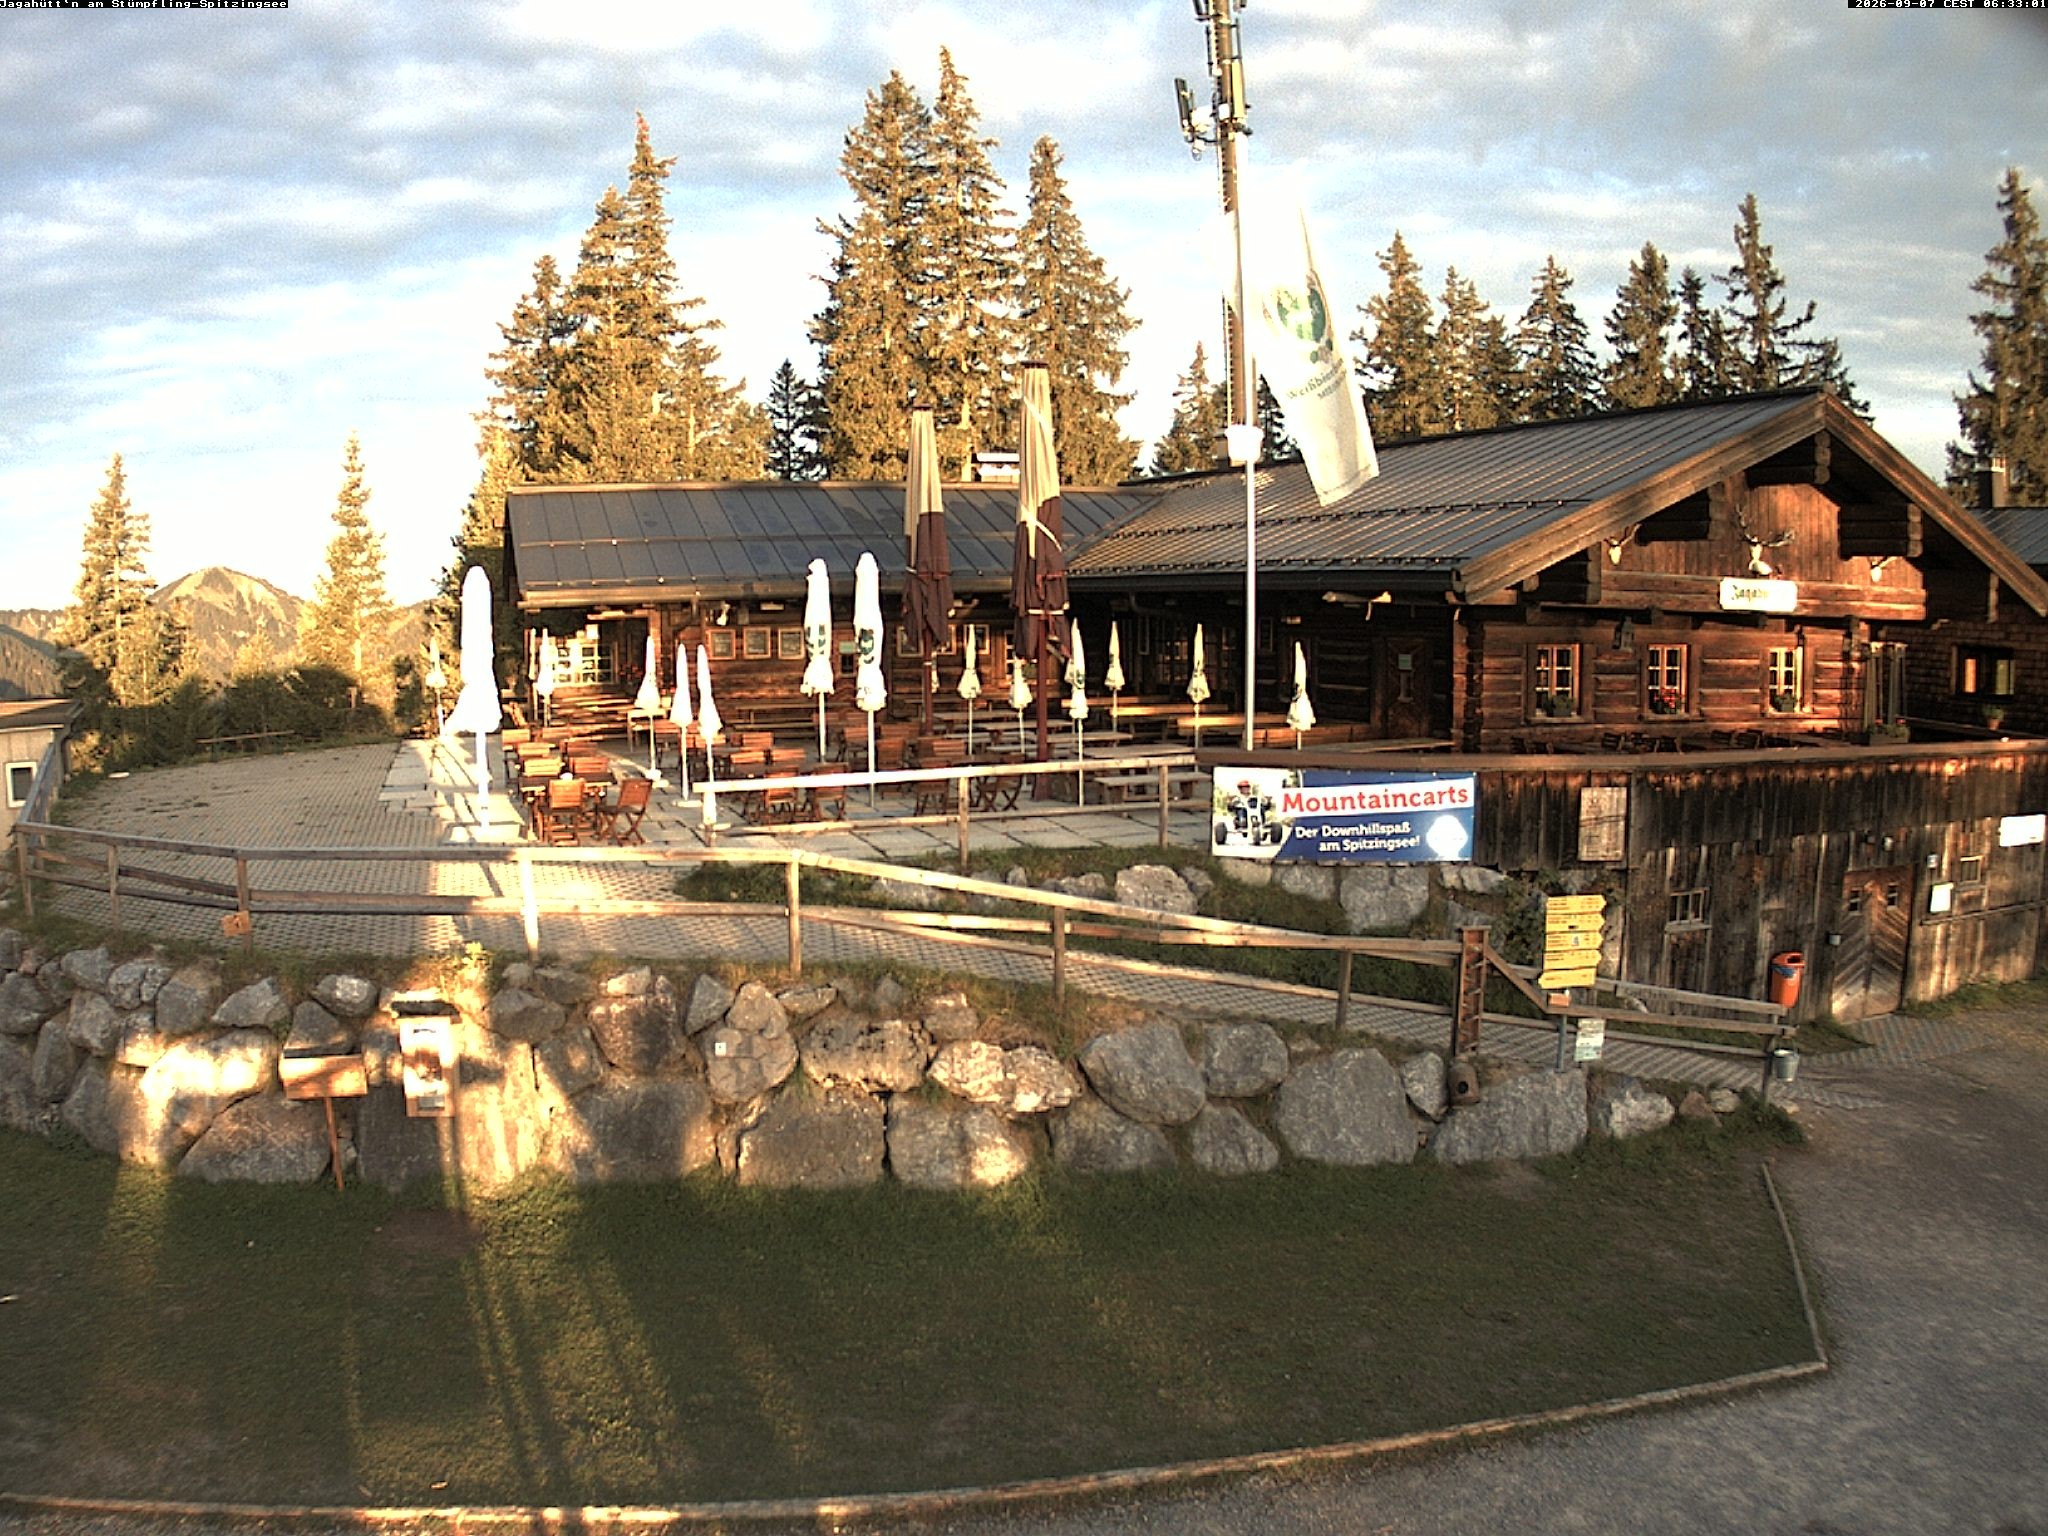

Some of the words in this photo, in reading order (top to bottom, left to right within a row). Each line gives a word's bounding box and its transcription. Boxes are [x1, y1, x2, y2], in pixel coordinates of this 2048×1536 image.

[1282, 786, 1469, 813] Mountaincarts
[1295, 826, 1318, 839] Der
[1321, 821, 1411, 838] Downhillspaß
[1318, 841, 1340, 852] am
[1341, 836, 1420, 853] Spitzingsee!
